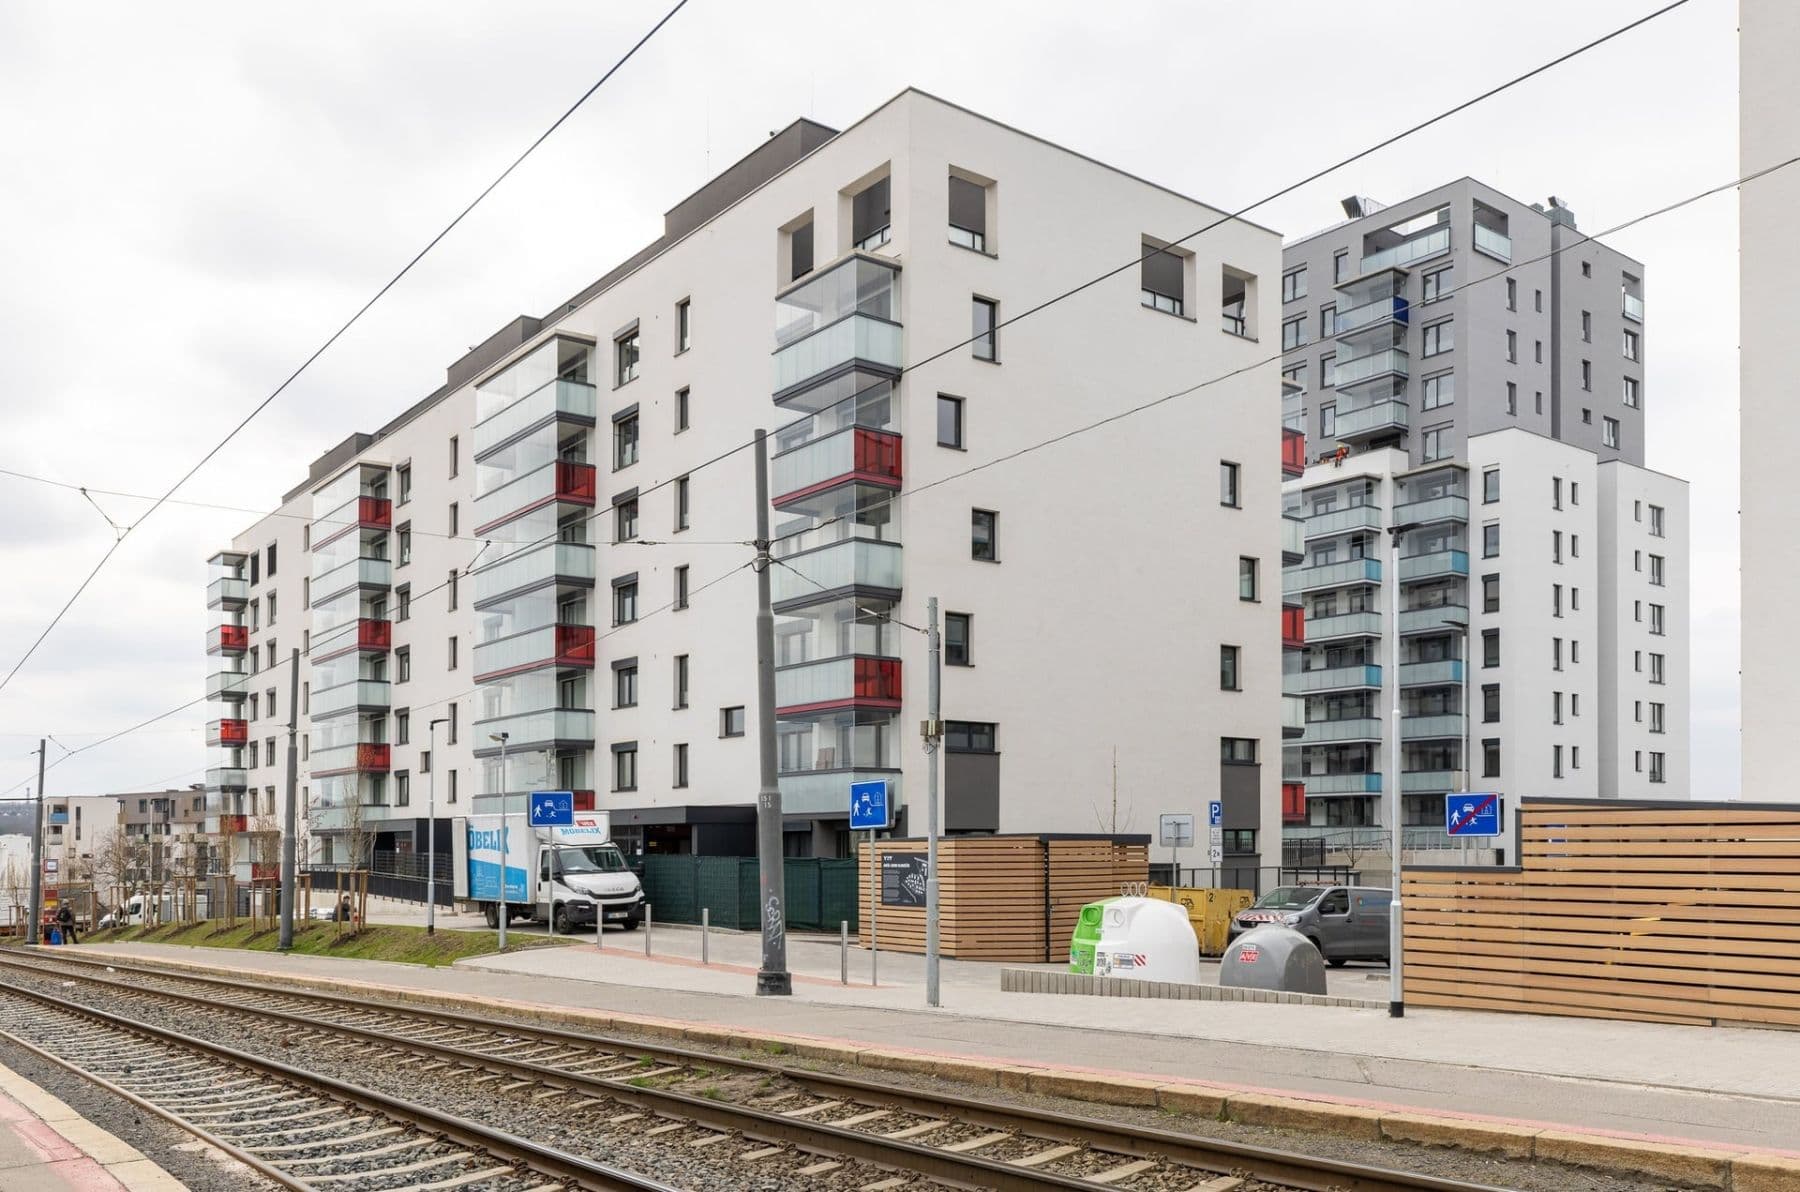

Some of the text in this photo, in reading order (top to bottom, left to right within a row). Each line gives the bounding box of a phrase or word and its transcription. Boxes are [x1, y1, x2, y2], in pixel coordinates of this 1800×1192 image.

[1211, 804, 1220, 818] P
[469, 825, 509, 854] ÖBELIX
[1208, 892, 1214, 902] 2
